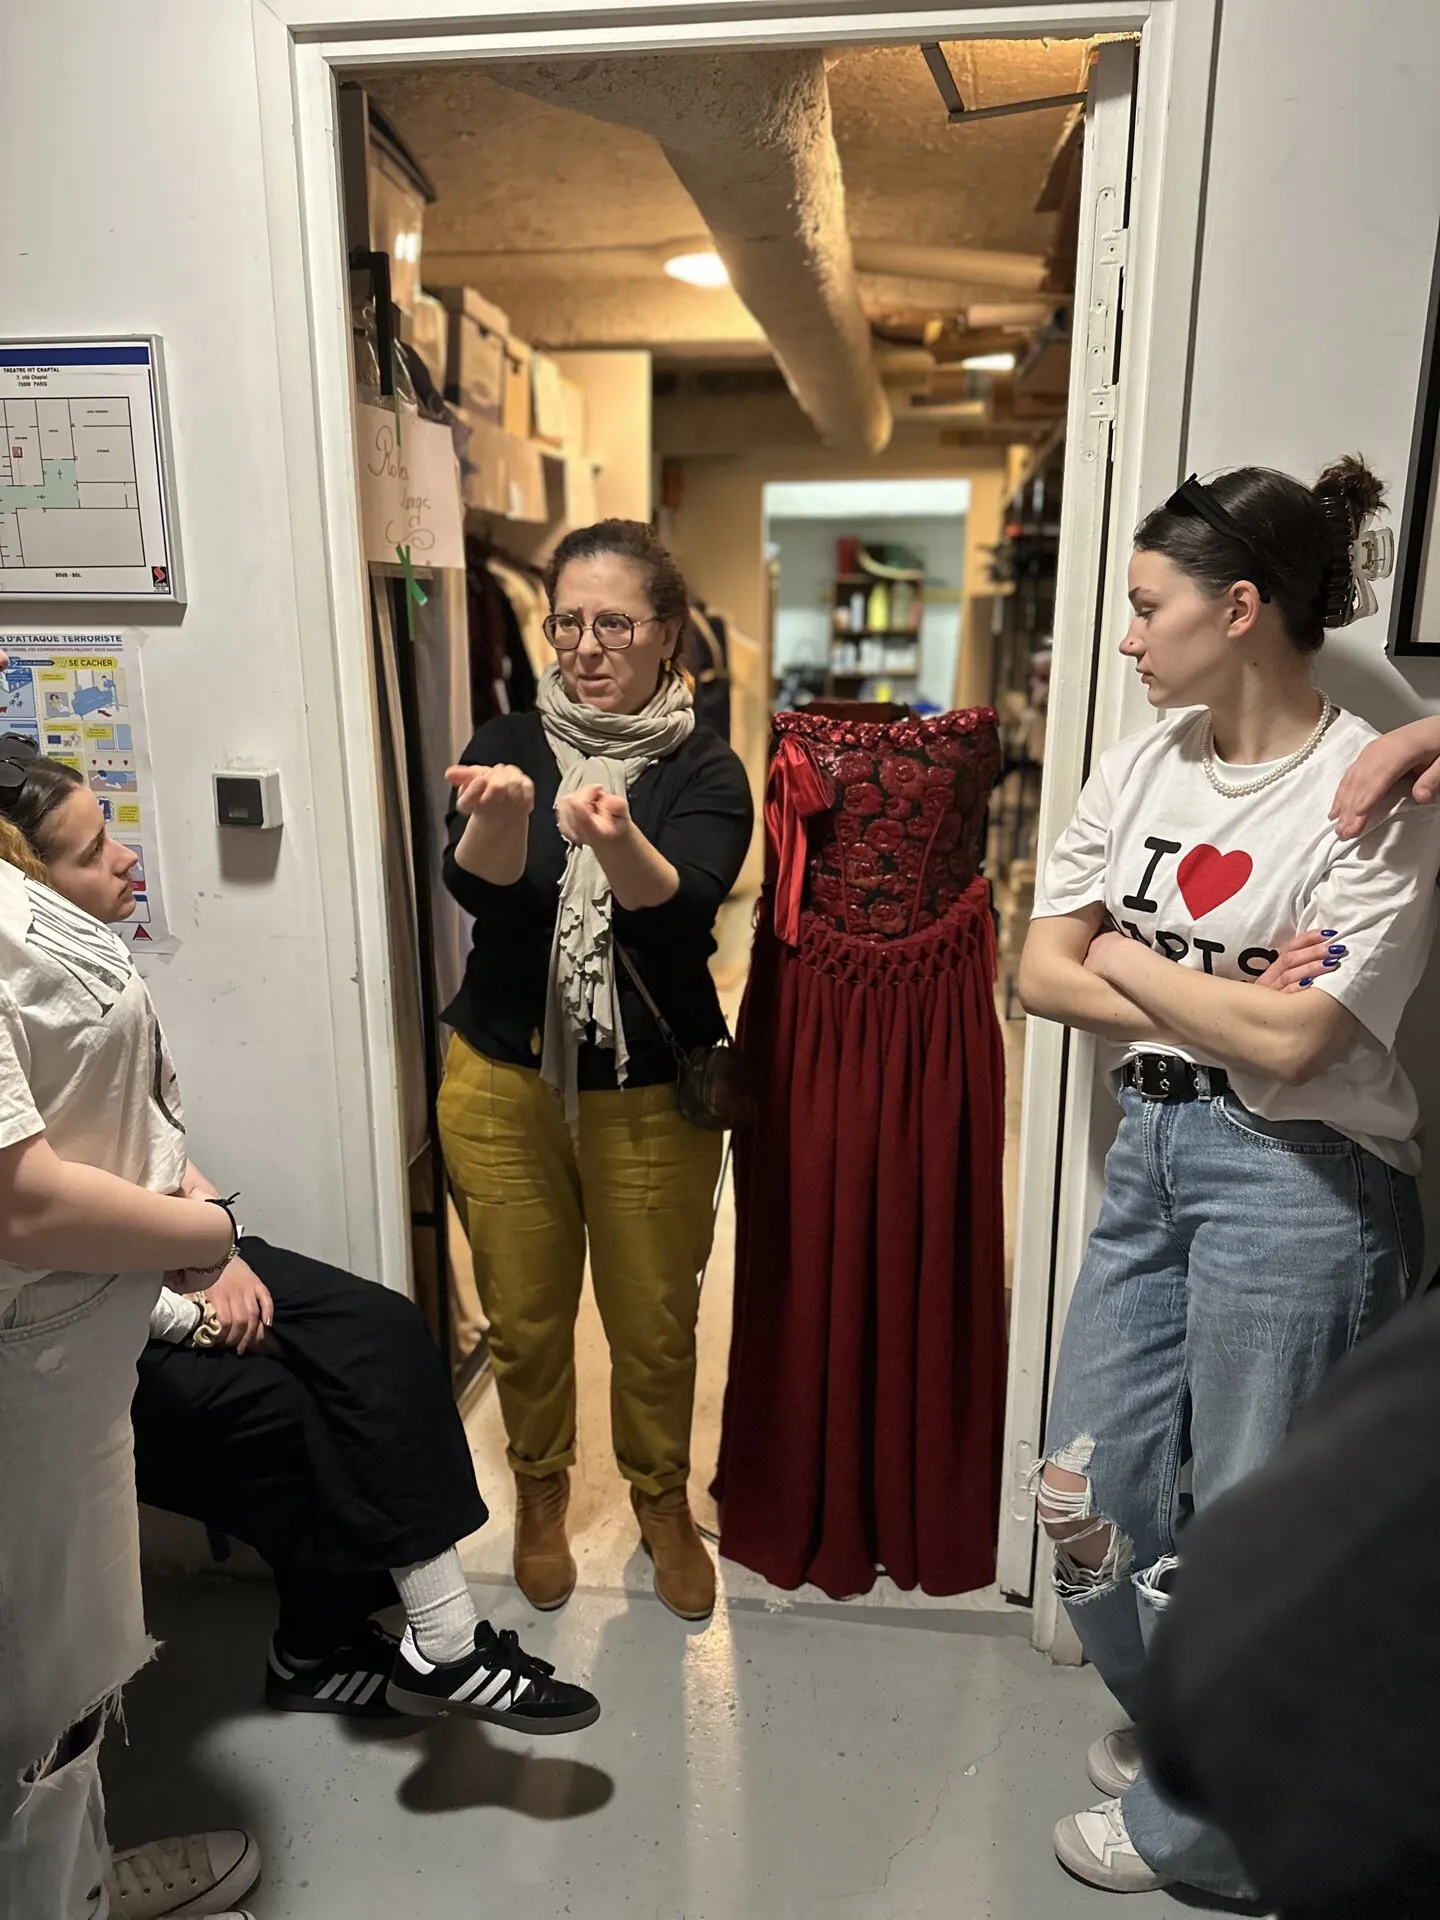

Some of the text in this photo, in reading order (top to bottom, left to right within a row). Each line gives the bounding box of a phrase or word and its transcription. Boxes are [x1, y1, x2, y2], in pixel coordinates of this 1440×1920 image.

[69, 659, 79, 667] SE
[80, 659, 113, 667] CACHER
[1122, 836, 1182, 914] I
